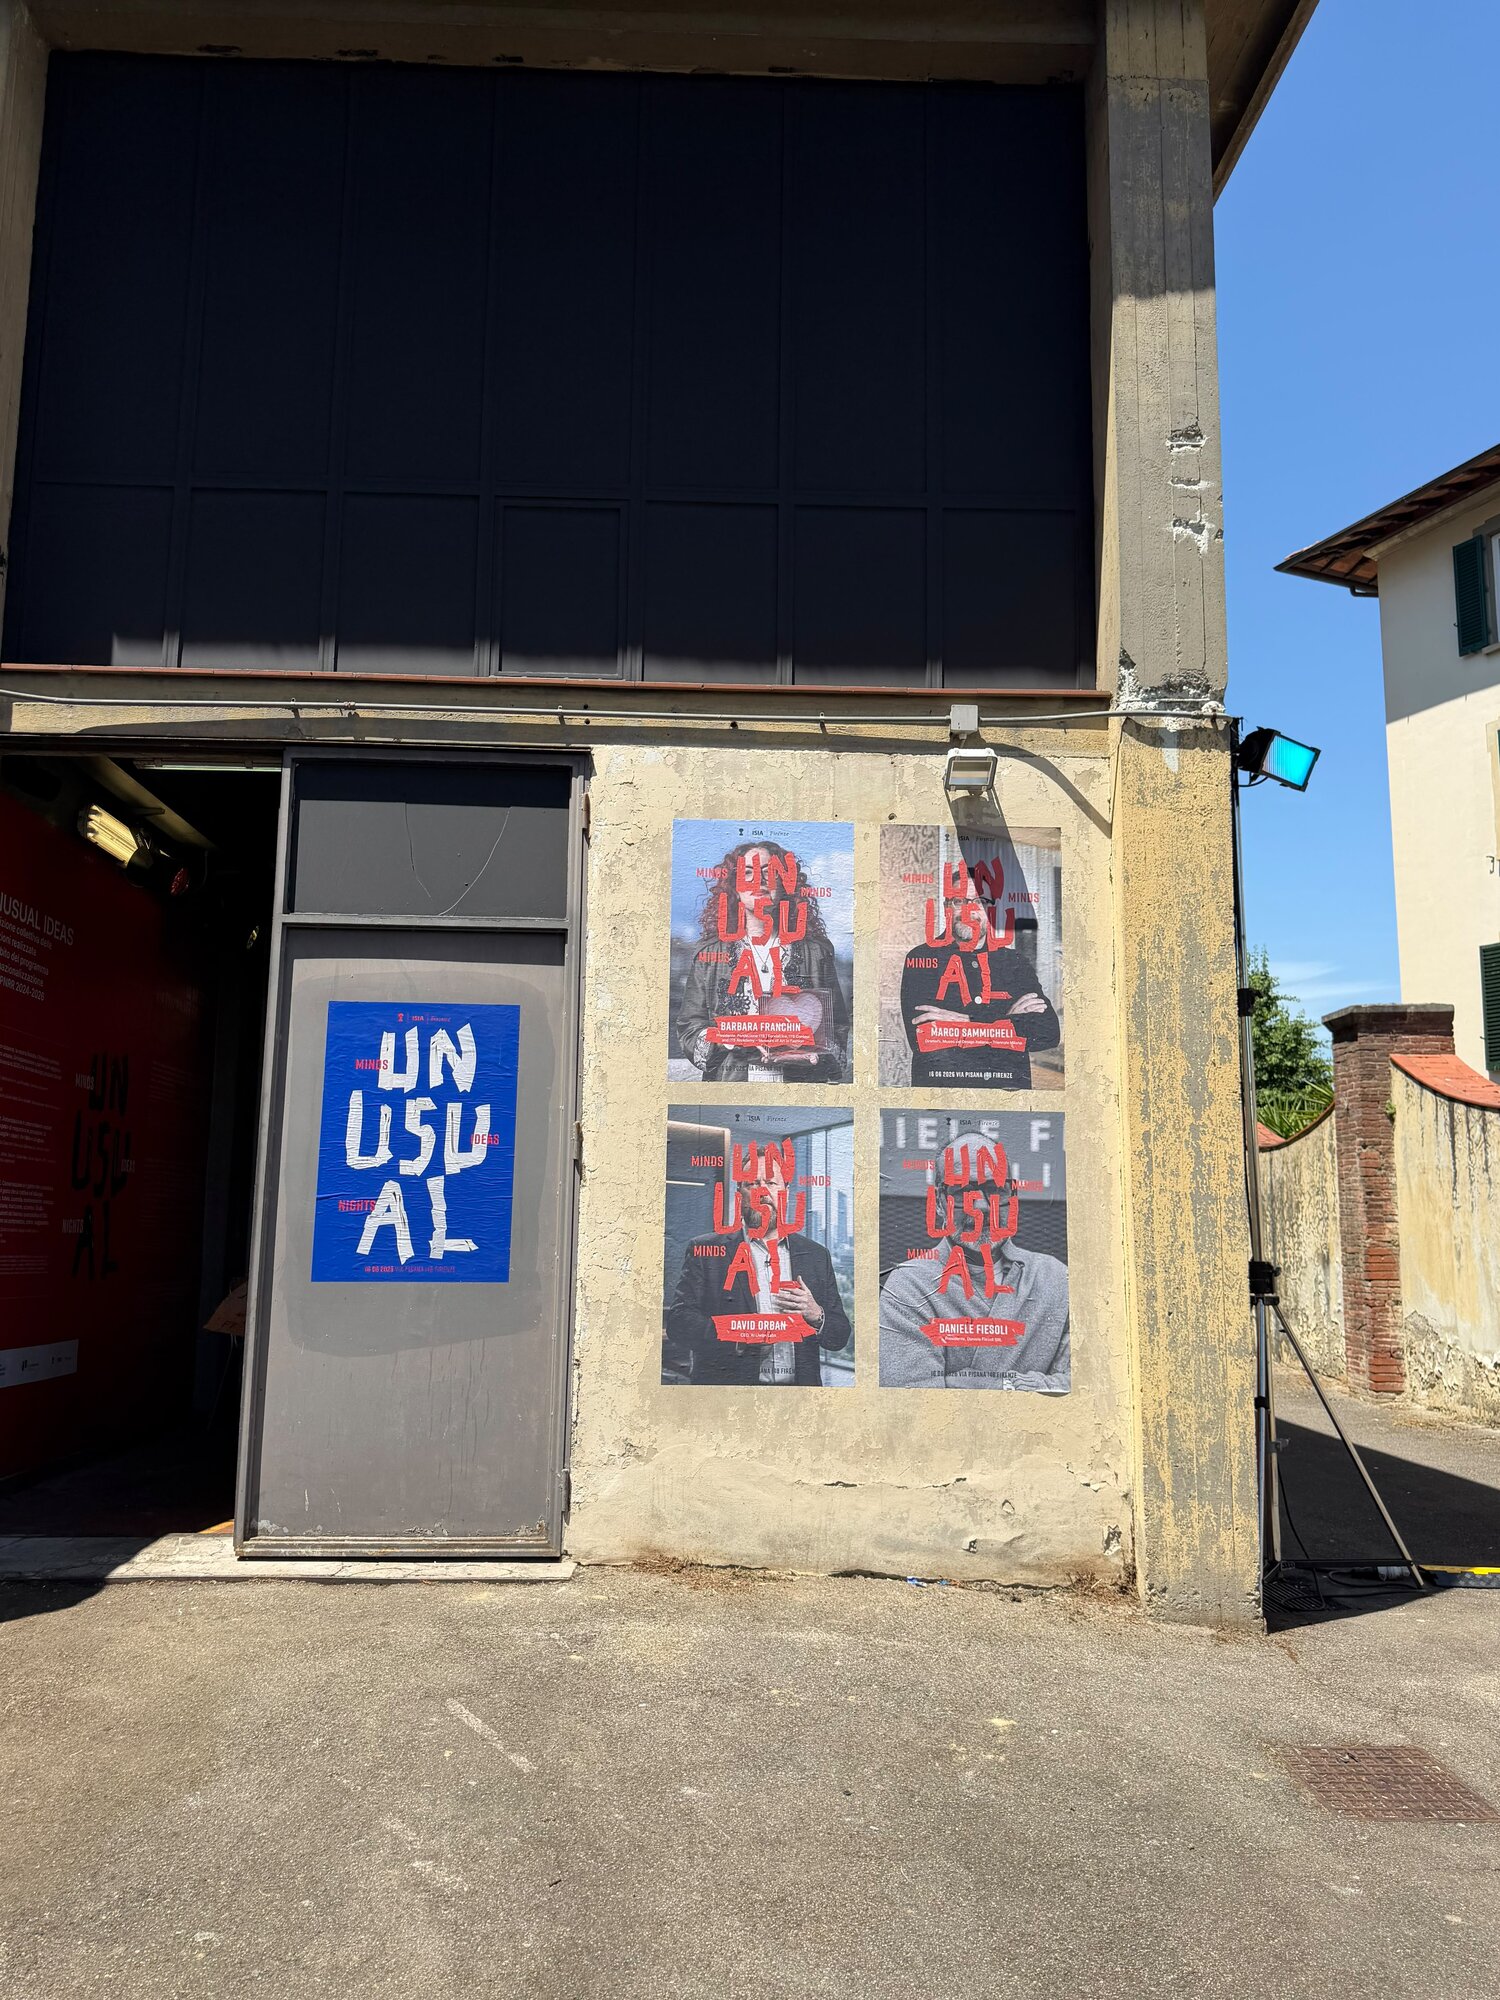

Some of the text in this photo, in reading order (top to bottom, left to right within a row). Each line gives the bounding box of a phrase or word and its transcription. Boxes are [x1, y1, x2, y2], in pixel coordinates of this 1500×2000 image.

[696, 867, 728, 879] MINDS
[736, 851, 798, 895] UN
[903, 872, 935, 884] MINDS
[943, 856, 1004, 901] UN
[800, 887, 832, 898] MINDS
[1008, 892, 1040, 903] MINDS
[718, 892, 808, 946] USU
[925, 898, 1015, 952] USU
[44, 914, 74, 946] IDEAS
[698, 952, 732, 963] MINDS
[906, 957, 938, 968] MINDS
[728, 946, 802, 1000] AL
[936, 952, 1012, 1006] AL
[720, 1022, 801, 1032] BARBARA FRANCHIN
[930, 1027, 1013, 1038] MARCO SAMMICHELI
[378, 1022, 477, 1094] UN
[355, 1059, 388, 1070] MINDS
[346, 1089, 491, 1176] USU
[470, 1132, 500, 1145] IDEAS
[690, 1156, 724, 1167] MINDS
[732, 1137, 796, 1183] UN
[944, 1142, 1008, 1188] UN
[798, 1176, 832, 1186] MINDS
[338, 1200, 376, 1212] NIGHTS
[713, 1181, 806, 1239] USU
[926, 1185, 1019, 1242] USU
[356, 1175, 479, 1265] AL
[693, 1245, 727, 1257] MINDS
[907, 1248, 940, 1260] MINDS
[938, 1243, 1016, 1301] AL
[731, 1320, 787, 1331] DAVID ORBAN
[939, 1323, 1008, 1335] DANIELE FIESOLI
